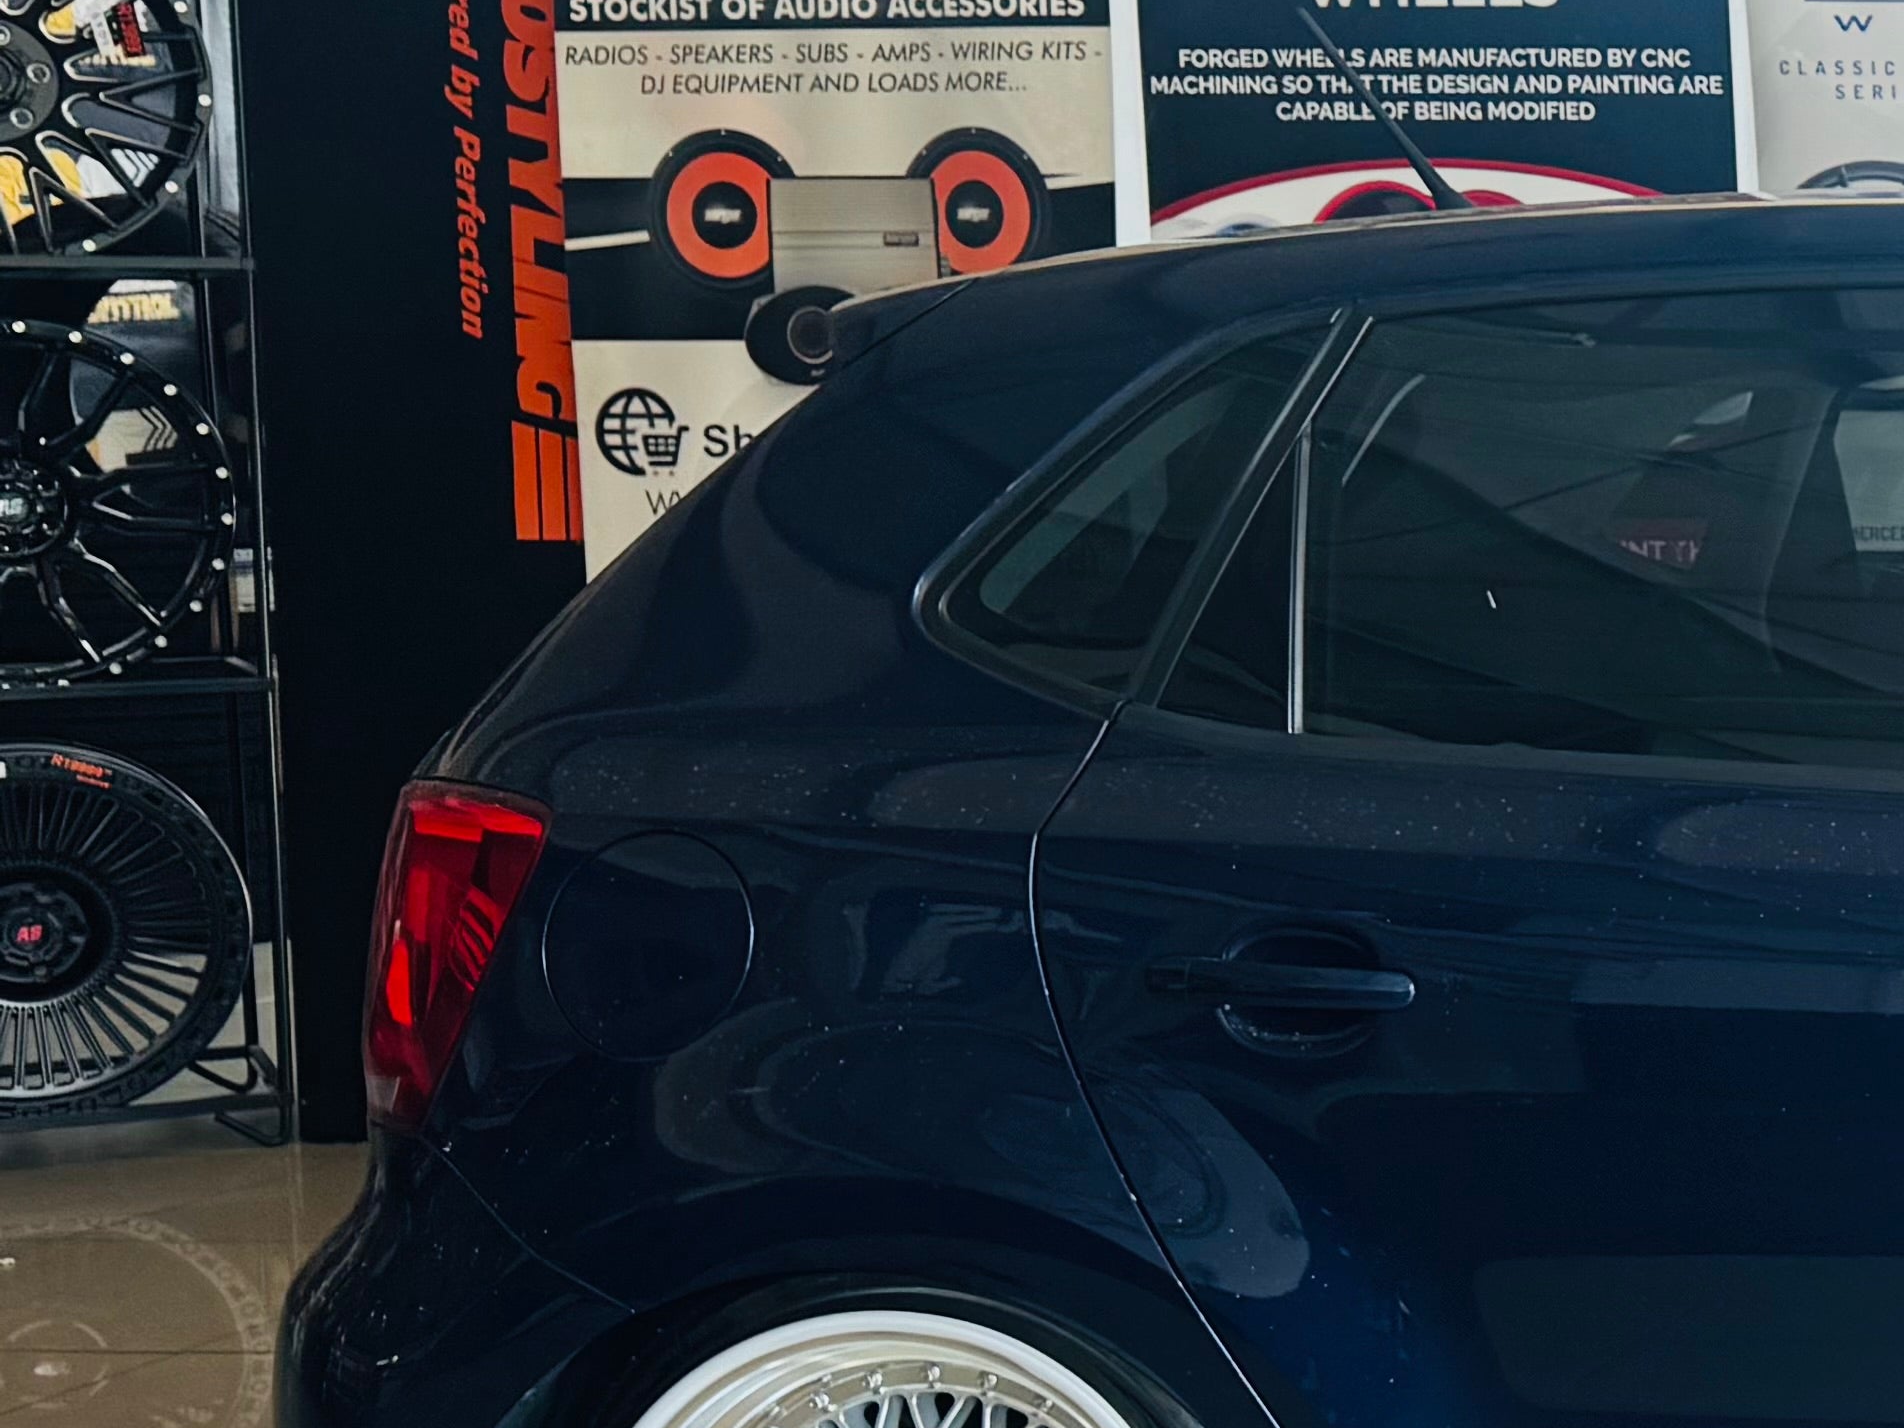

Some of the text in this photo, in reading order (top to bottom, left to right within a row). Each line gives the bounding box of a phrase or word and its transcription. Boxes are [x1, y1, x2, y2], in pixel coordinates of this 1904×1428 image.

[565, 40, 1088, 66] RADIOS SPEAKERS SUBS AMPS WIRING KITS
[1178, 47, 1691, 69] FORGED ARE MANUFACTURED CNC
[1779, 60, 1897, 77] CLASSIC
[641, 73, 939, 95] DJ EQUIPMENT AND LOADS
[1150, 74, 1724, 96] MACHINING SO THE DESIGN AND PAINTING ARE
[447, 70, 478, 121] by
[1413, 100, 1596, 122] BEING MODIFIED
[450, 125, 486, 341] Perfection
